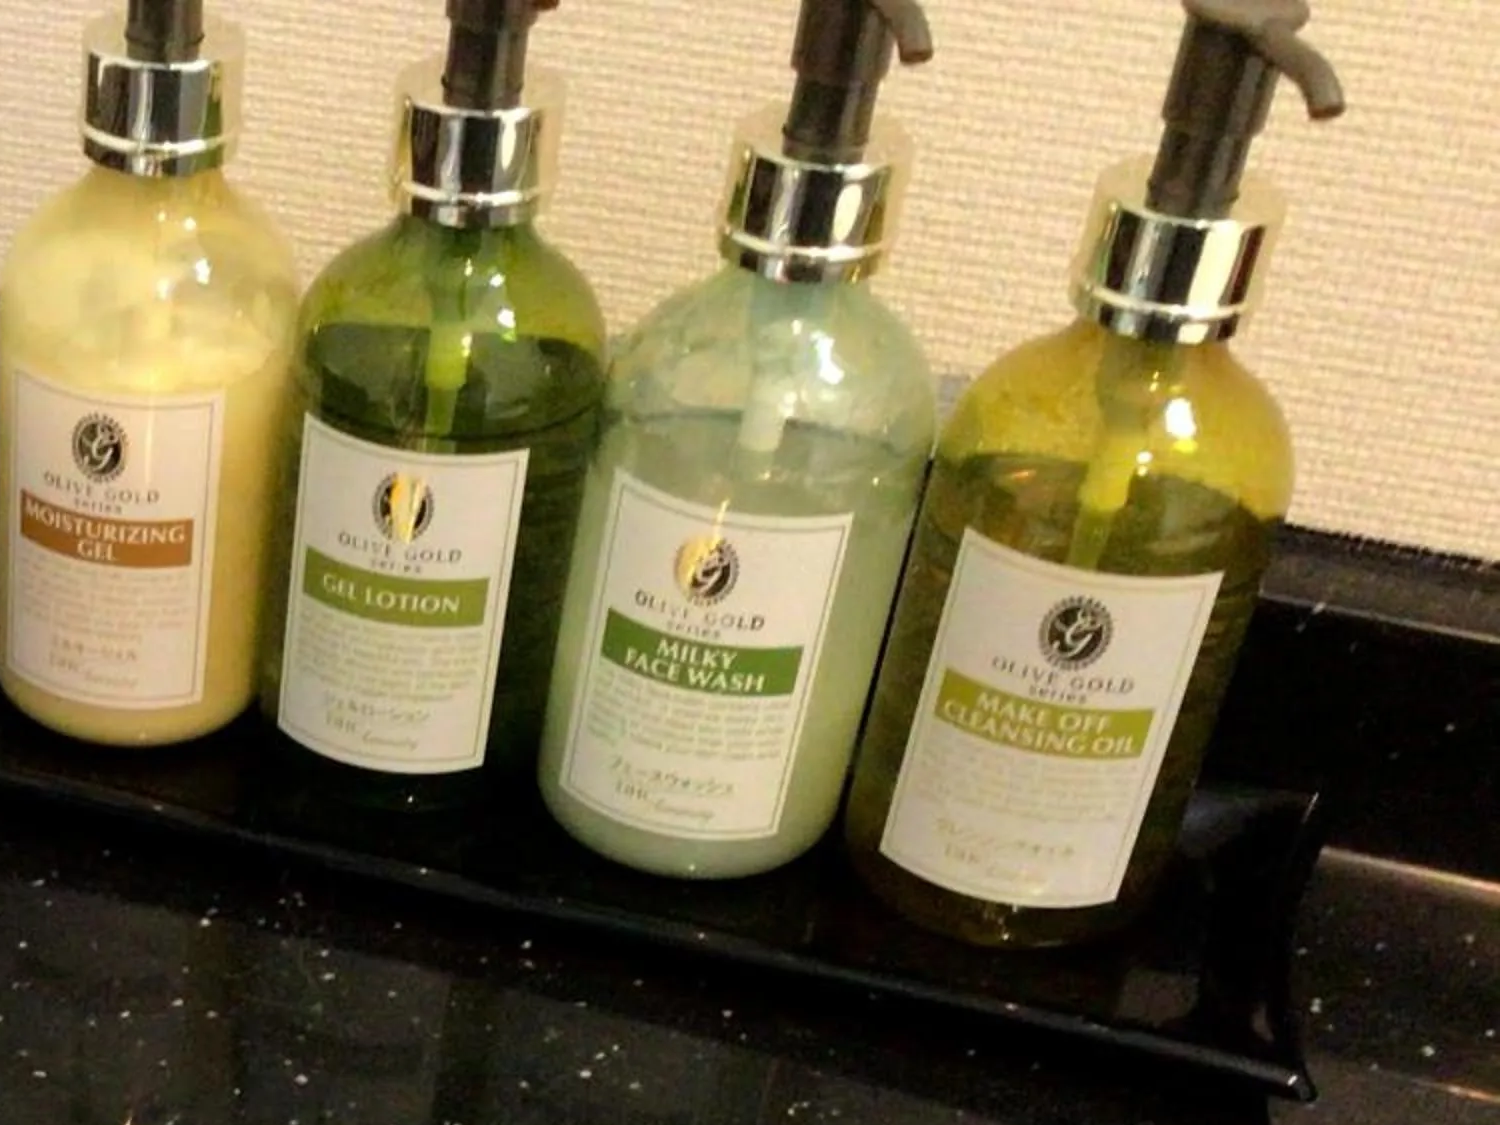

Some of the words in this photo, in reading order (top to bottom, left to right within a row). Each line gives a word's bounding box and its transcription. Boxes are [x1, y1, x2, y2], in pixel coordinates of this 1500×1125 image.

[43, 472, 91, 496] OLIVE
[105, 489, 158, 501] GOLD
[25, 500, 184, 544] MOISTURIZING
[77, 540, 115, 561] GEL
[339, 531, 389, 556] OLIVE
[404, 548, 461, 563] GOLD
[322, 574, 355, 599] GEL
[365, 587, 459, 613] LOTION
[704, 612, 764, 630] GOLD
[625, 648, 679, 680] FACE
[688, 671, 765, 691] WASH
[656, 639, 737, 669] MILKY
[991, 656, 1059, 686] OLIVE
[1070, 674, 1134, 693] GOLD
[943, 700, 1087, 752] CLEANSING
[1091, 735, 1133, 753] OIL
[976, 691, 1046, 726] MAKE
[1058, 711, 1110, 733] OFF
